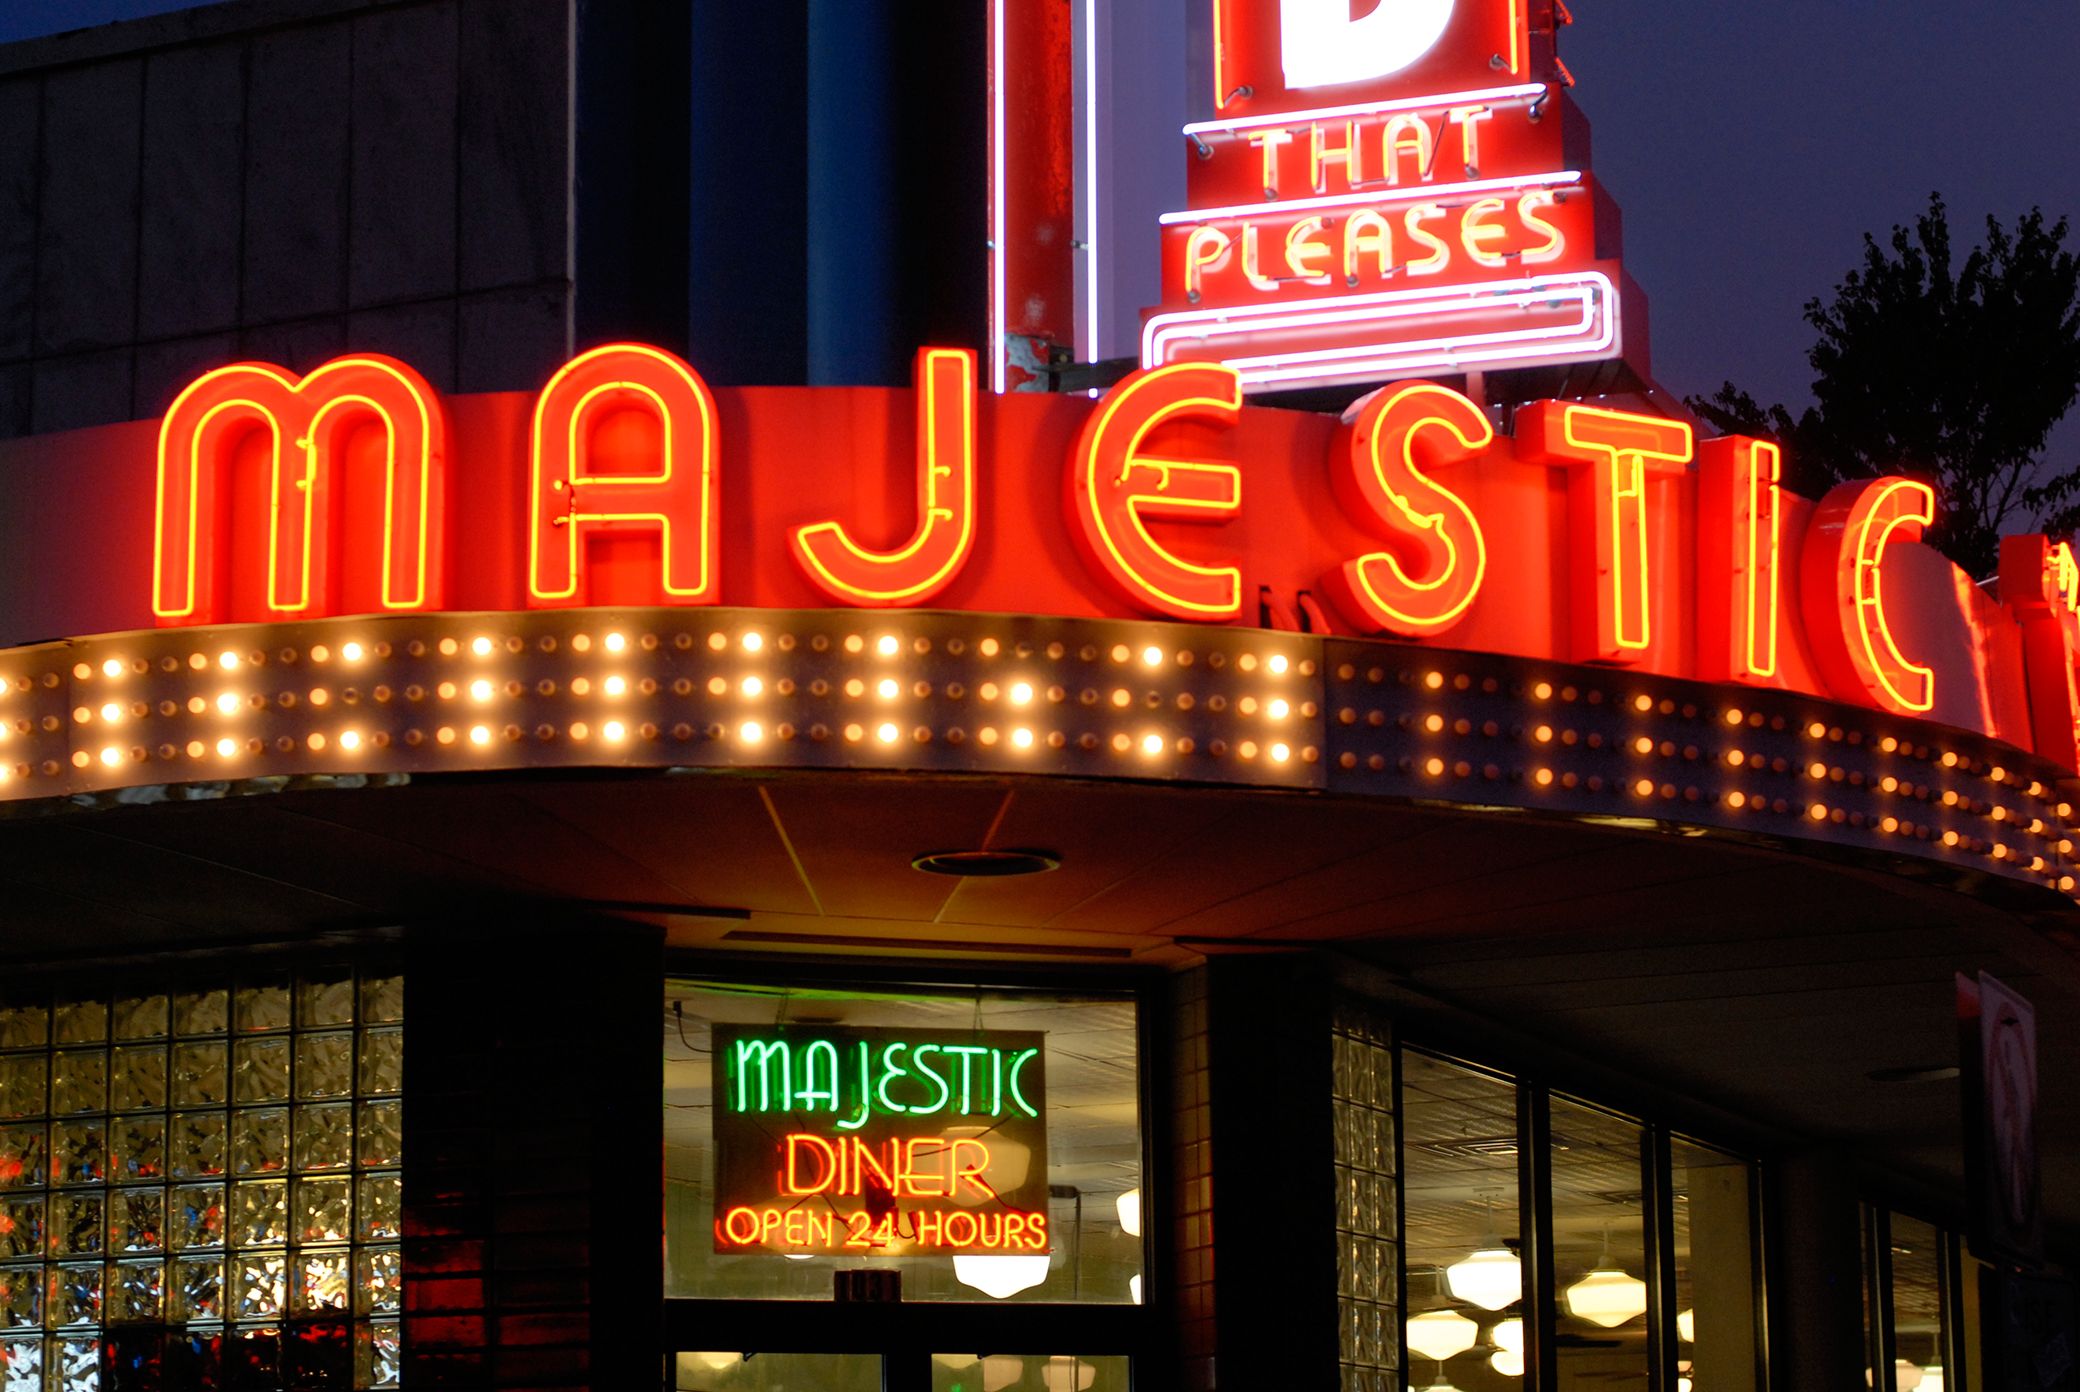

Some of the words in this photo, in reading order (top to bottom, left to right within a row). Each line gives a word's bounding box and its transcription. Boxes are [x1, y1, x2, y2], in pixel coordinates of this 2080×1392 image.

[1247, 104, 1493, 194] THAT
[1184, 190, 1567, 292] PLEASES
[150, 340, 1935, 718] MAJESTIC
[734, 1038, 1038, 1130] MAJESTIC
[785, 1133, 996, 1199] DINER
[724, 1206, 834, 1248] OPEN
[845, 1210, 899, 1249] 24
[917, 1209, 1048, 1250] HOURS
